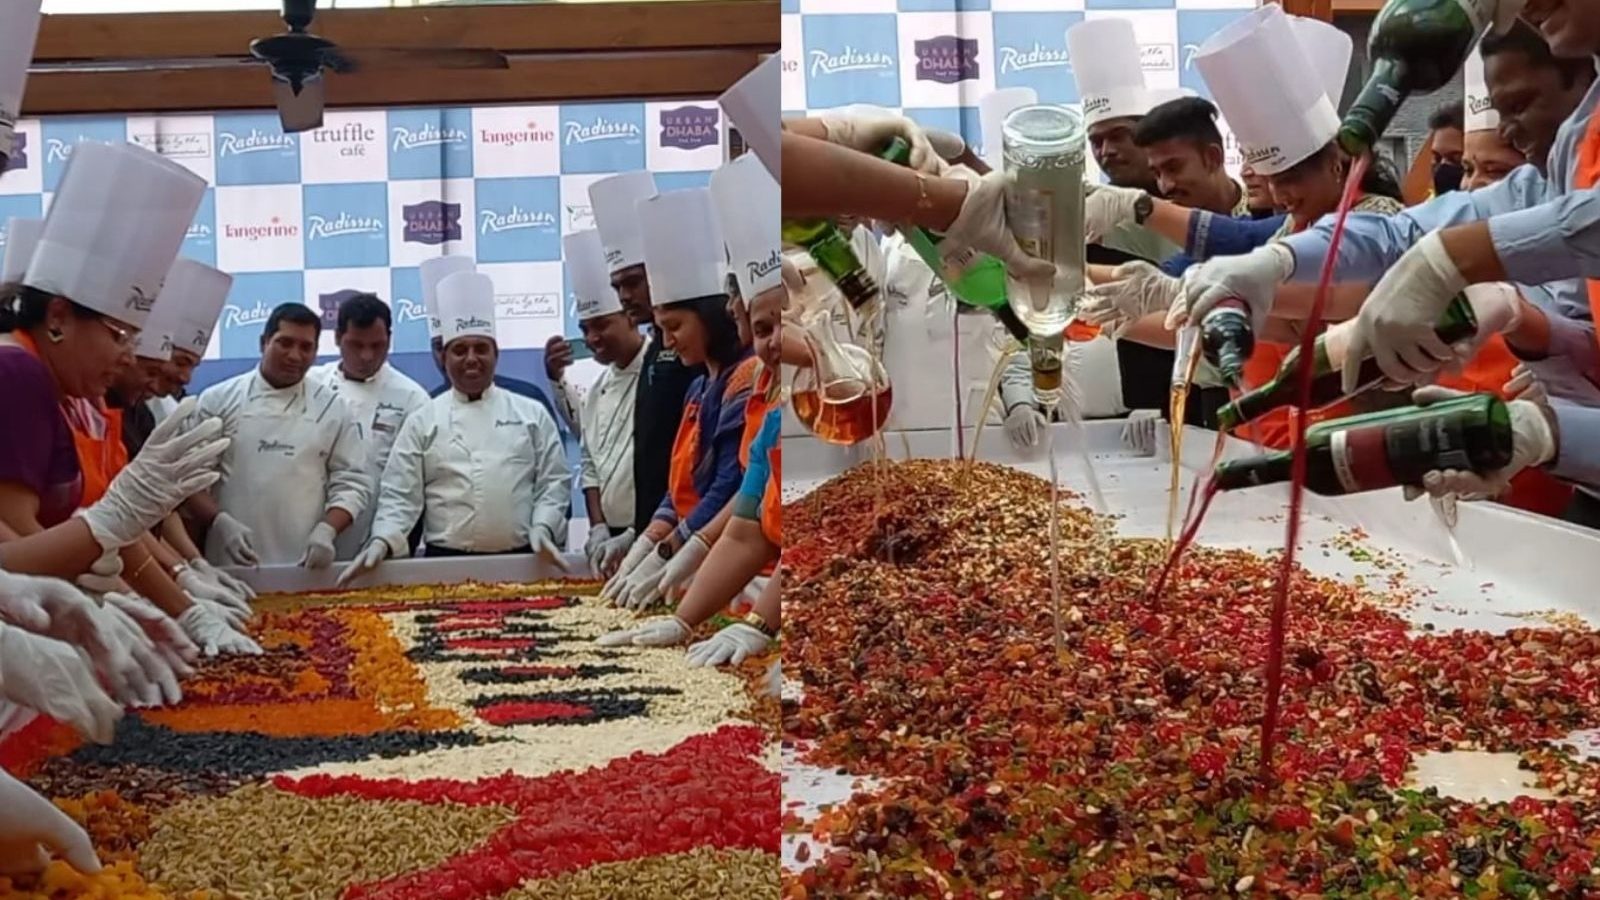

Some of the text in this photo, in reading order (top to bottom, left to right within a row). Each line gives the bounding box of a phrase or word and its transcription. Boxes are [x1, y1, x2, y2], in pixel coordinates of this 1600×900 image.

[809, 45, 893, 79] Radisson
[219, 128, 295, 158] Radisson
[313, 123, 375, 143] truffle
[393, 122, 468, 153] Radisson
[481, 121, 554, 146] Tangerine
[565, 117, 640, 145] Radisson
[666, 125, 712, 138] DHABA
[225, 217, 298, 241] Tangerine
[309, 212, 384, 241] Radisson
[481, 205, 556, 235] Radisson
